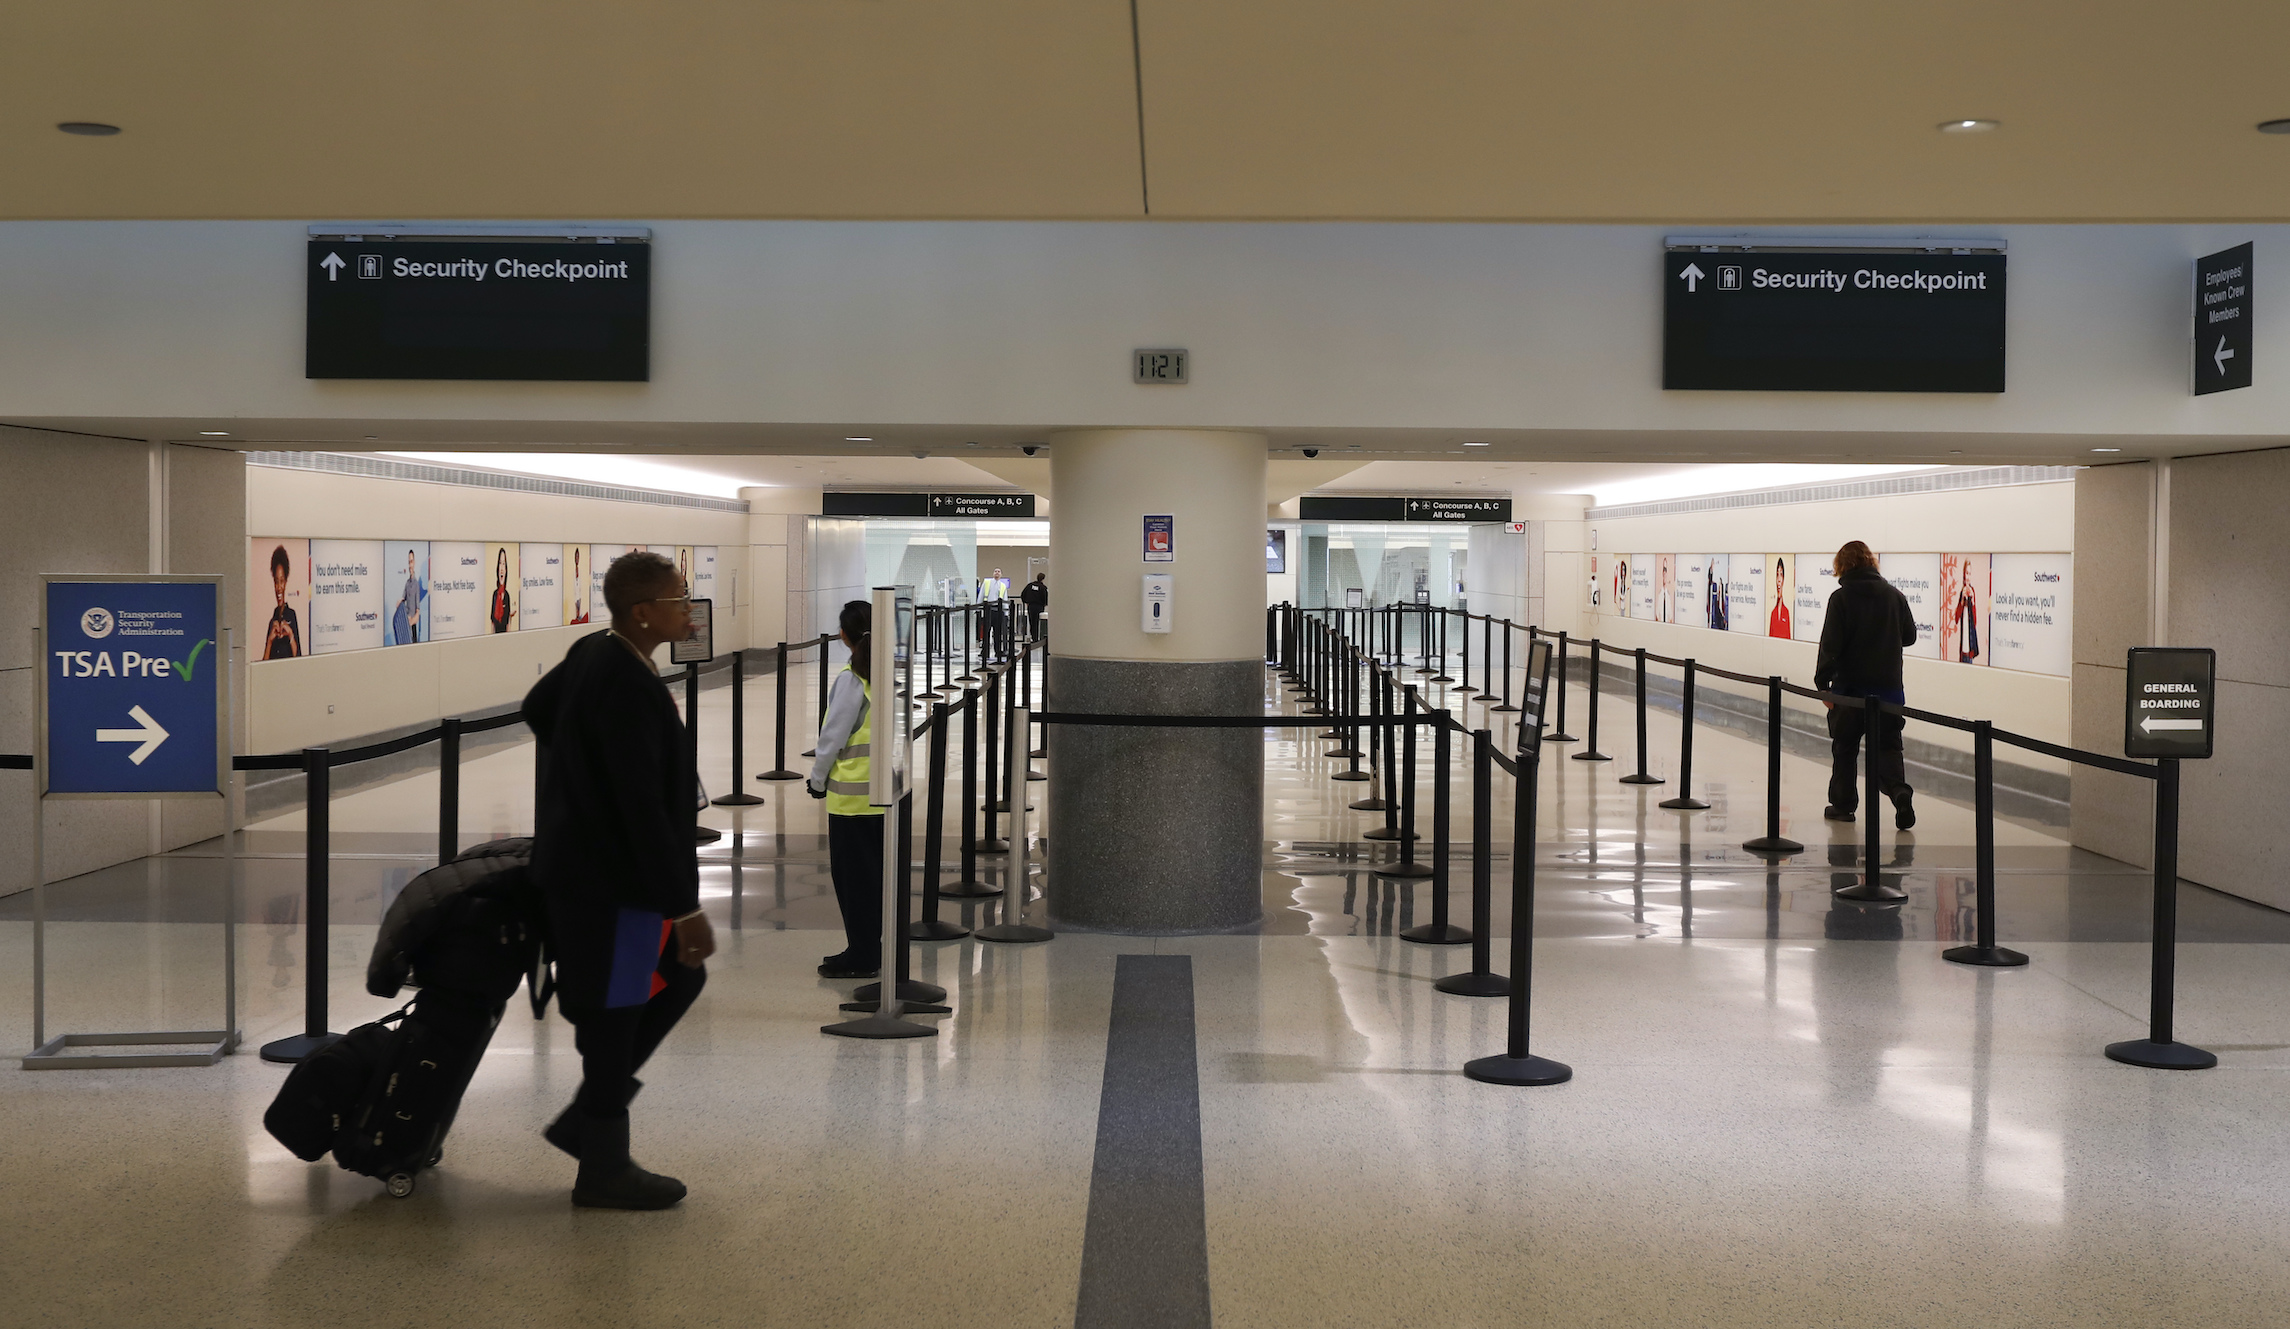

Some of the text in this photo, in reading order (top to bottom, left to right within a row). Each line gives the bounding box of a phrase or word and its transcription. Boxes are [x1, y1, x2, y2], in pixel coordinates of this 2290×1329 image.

[393, 257, 628, 282] Security Checkpoint
[2206, 262, 2244, 287] Employees/
[1752, 268, 1986, 293] Security Checkpoint
[2204, 284, 2245, 306] Known Crew
[2209, 306, 2240, 324] Members
[997, 498, 1005, 506] A,
[1006, 498, 1014, 506] B,
[316, 563, 368, 576] You don't need miles
[2034, 572, 2057, 583] Southwest
[316, 584, 321, 594] to
[322, 584, 334, 594] earn
[335, 582, 344, 594] this
[1897, 578, 1909, 590] flights
[1910, 578, 1920, 588] make
[1921, 580, 1929, 591] you
[1996, 592, 2007, 604] Look
[2015, 596, 2024, 608] you
[118, 610, 182, 620] Transportation
[355, 612, 375, 622] Southwest
[1995, 610, 2053, 625] never find a hidden fee.
[118, 620, 155, 628] Security
[118, 628, 184, 636] Administration
[55, 651, 116, 678] TSA
[122, 651, 170, 678] Pre
[2144, 684, 2198, 693] GENERAL
[2140, 699, 2200, 709] BOARDING
